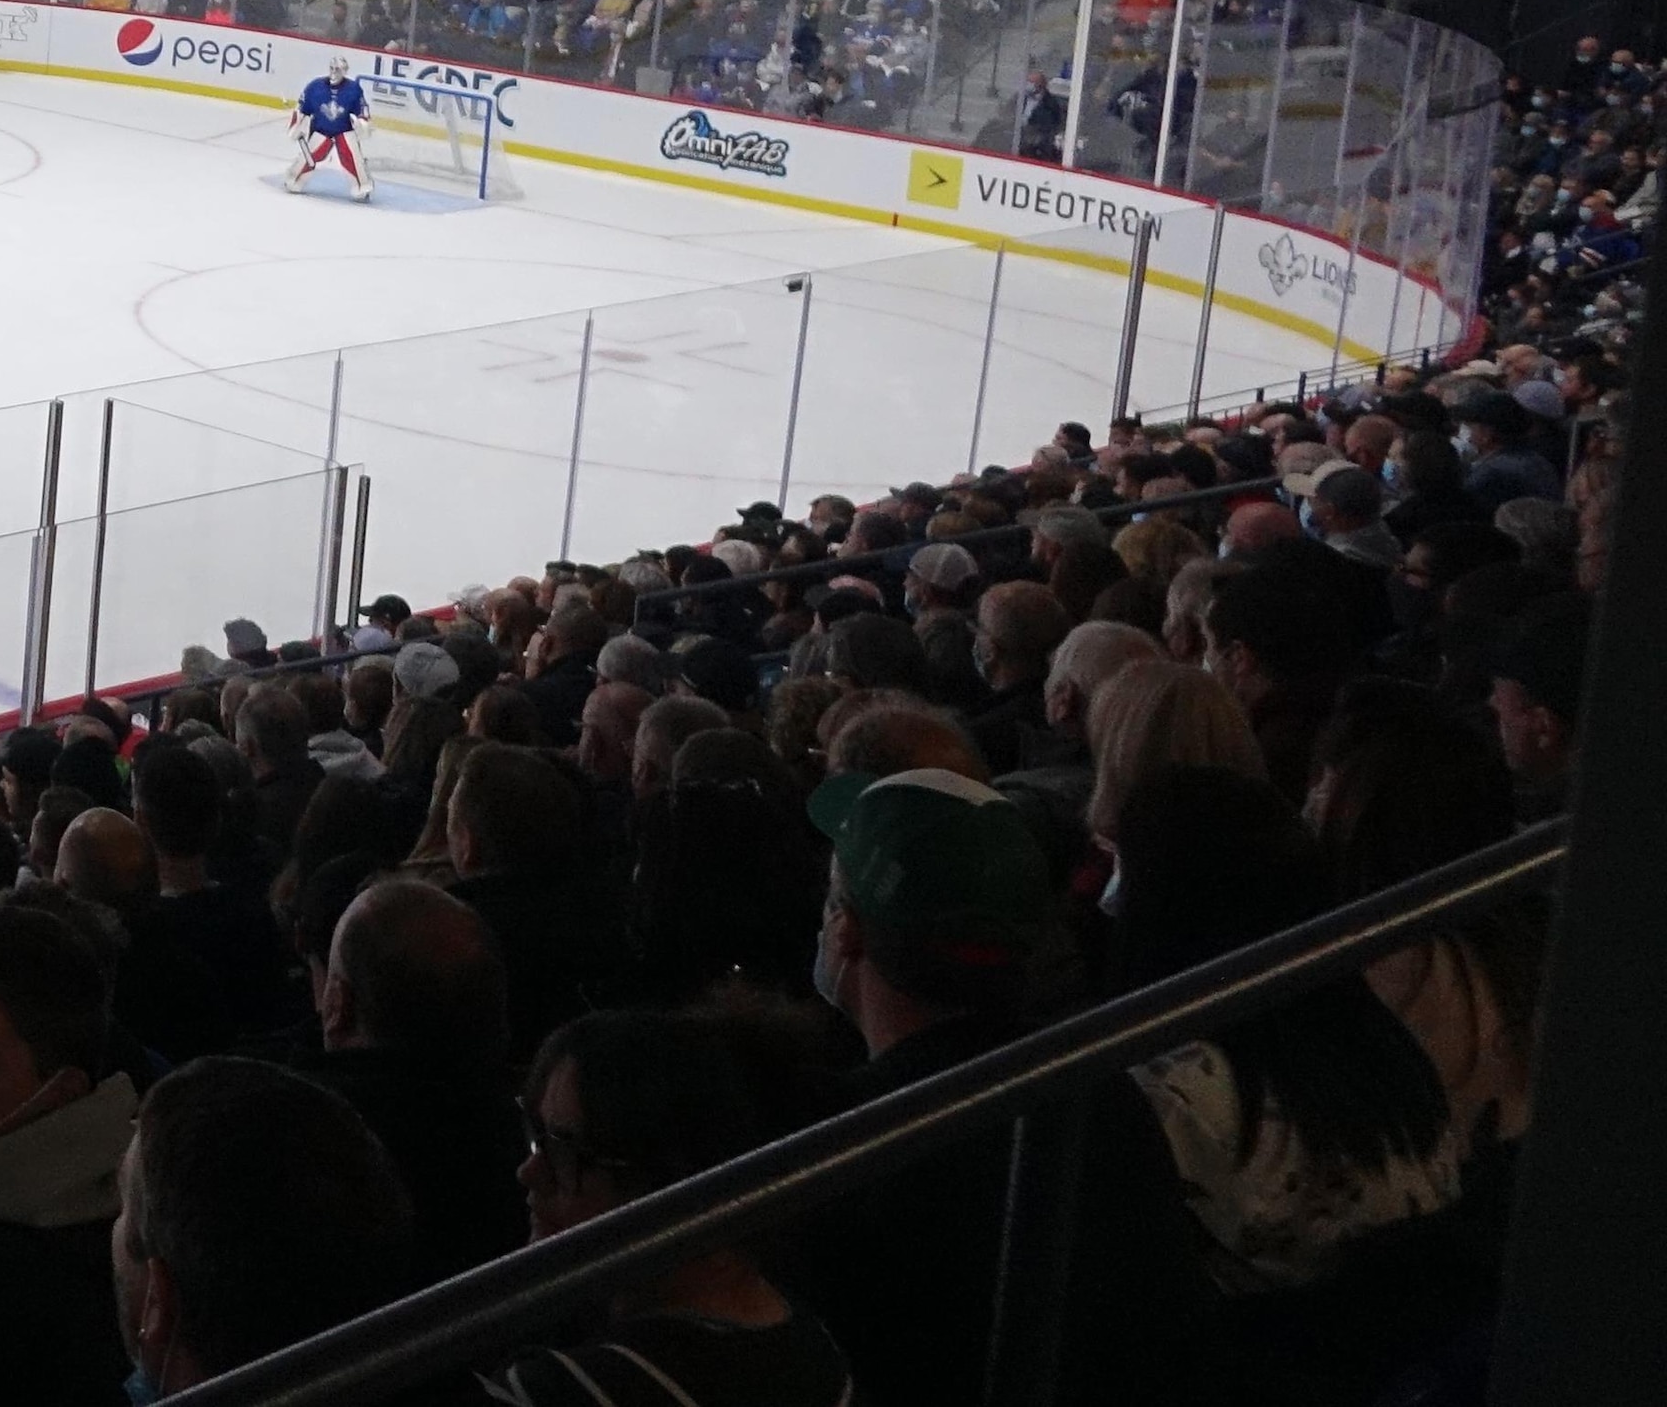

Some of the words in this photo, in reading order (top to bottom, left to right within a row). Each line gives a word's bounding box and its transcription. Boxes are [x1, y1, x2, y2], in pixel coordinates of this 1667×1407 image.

[173, 36, 273, 74] pepsi
[372, 55, 409, 96] LE
[977, 174, 1163, 243] VIDÉOTRON
